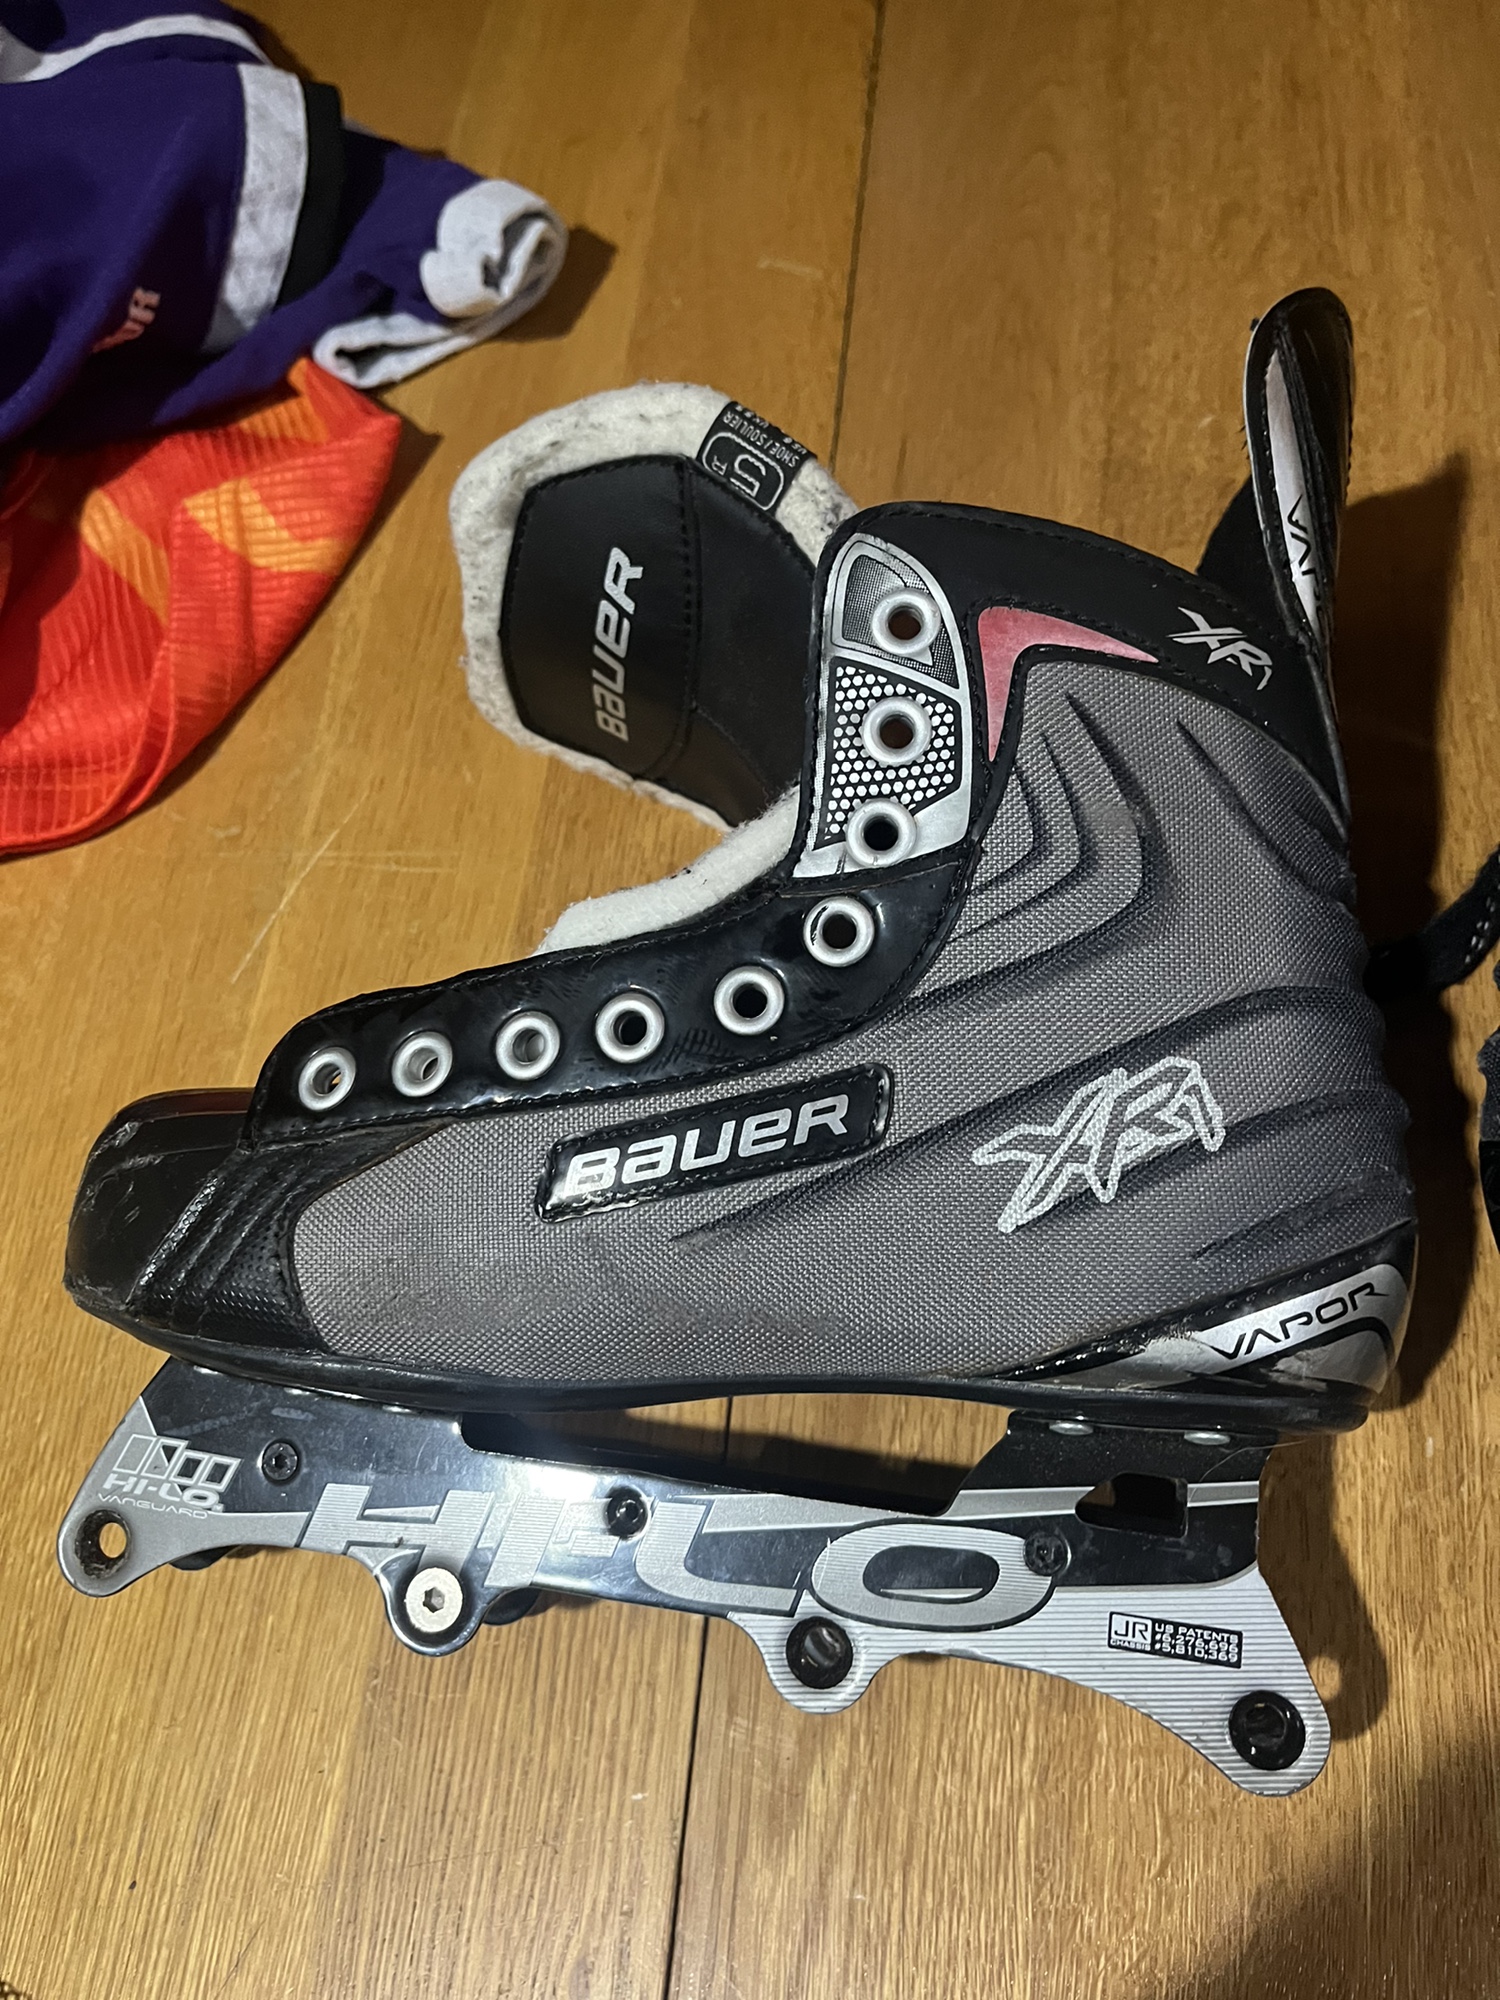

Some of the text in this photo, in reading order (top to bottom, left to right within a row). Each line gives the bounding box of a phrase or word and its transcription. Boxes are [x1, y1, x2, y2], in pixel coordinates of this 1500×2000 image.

[592, 547, 644, 742] BAUER
[564, 1094, 849, 1198] BAUER
[1210, 1282, 1390, 1361] VAPOR
[98, 1493, 208, 1519] VANGUARD
[102, 1473, 220, 1509] HI-LO
[1110, 1638, 1151, 1652] CHASSIS
[1113, 1620, 1149, 1642] JR
[1154, 1622, 1239, 1645] US PATENTS
